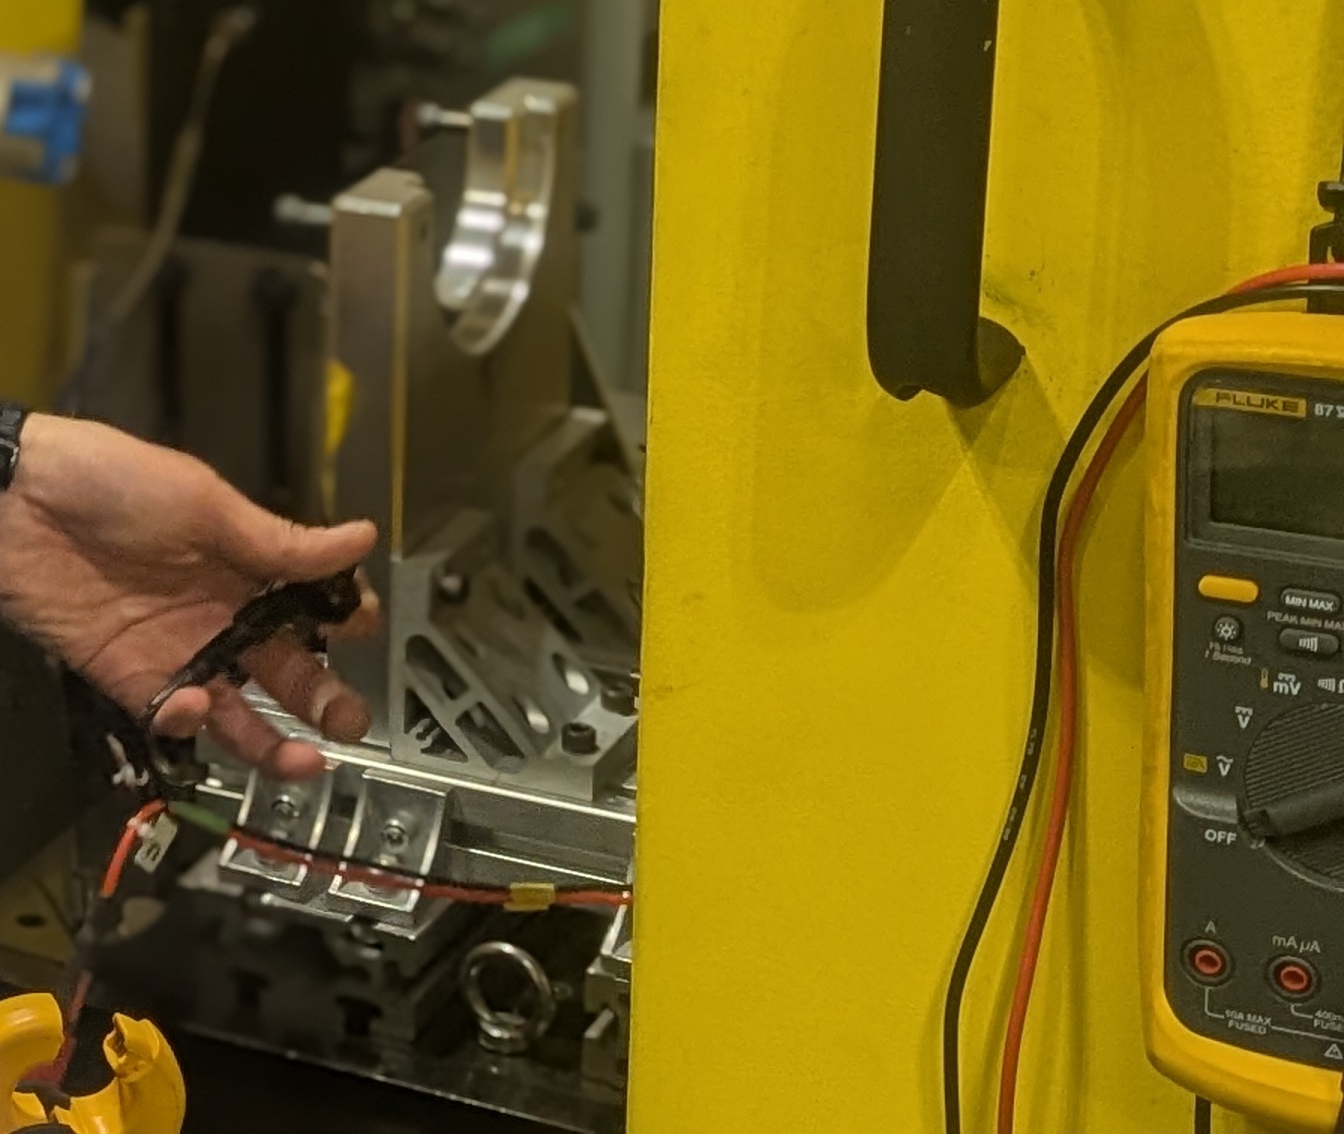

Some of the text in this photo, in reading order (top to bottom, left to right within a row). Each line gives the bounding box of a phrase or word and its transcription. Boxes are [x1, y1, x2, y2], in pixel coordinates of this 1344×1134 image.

[1215, 392, 1299, 413] FLUKE
[1285, 595, 1334, 612] MIN MAX
[1267, 610, 1298, 624] PEAK
[1300, 616, 1322, 627] MIN
[1204, 829, 1237, 844] OFF
[1205, 920, 1216, 934] A
[1272, 935, 1298, 949] mA
[1228, 1020, 1267, 1035] FUSED
[1246, 1013, 1272, 1027] MAX
